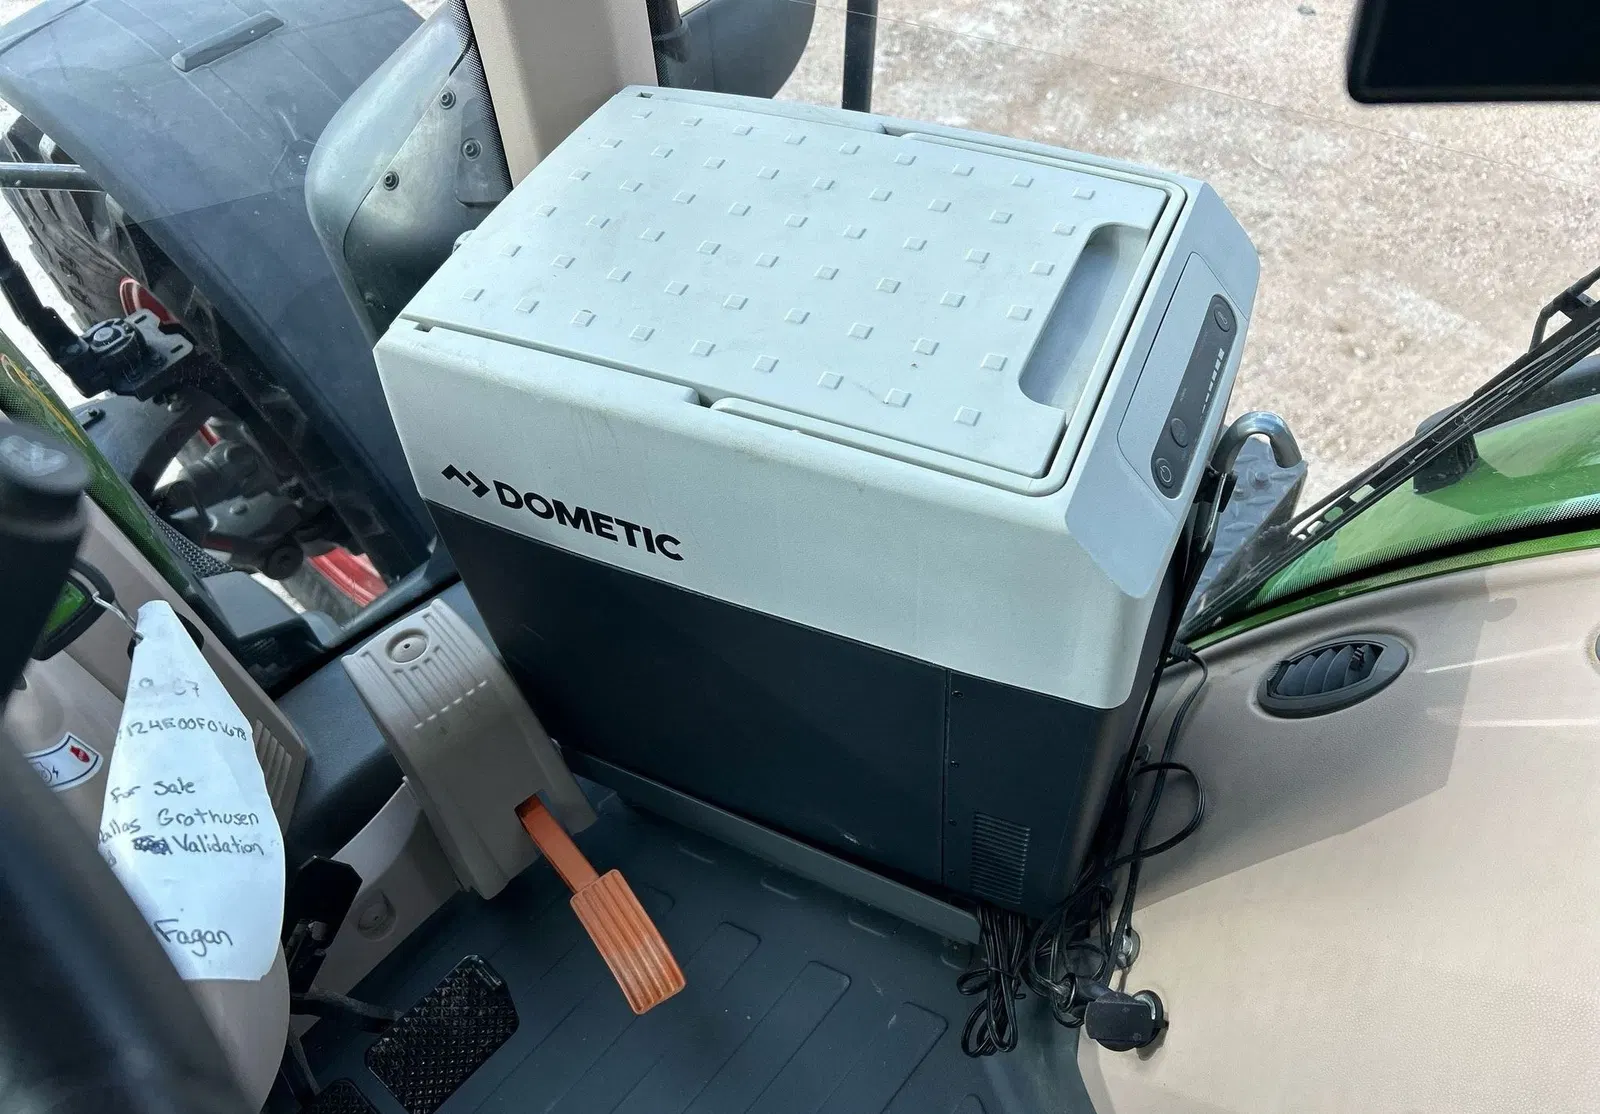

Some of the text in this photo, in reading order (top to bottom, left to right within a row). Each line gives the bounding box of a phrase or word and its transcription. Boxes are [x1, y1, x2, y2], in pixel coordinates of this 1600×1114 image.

[493, 480, 684, 561] DOMETIC
[153, 777, 196, 796] Sale
[157, 808, 259, 827] Grothusen
[172, 833, 265, 856] Validation
[154, 918, 233, 958] Fagan
